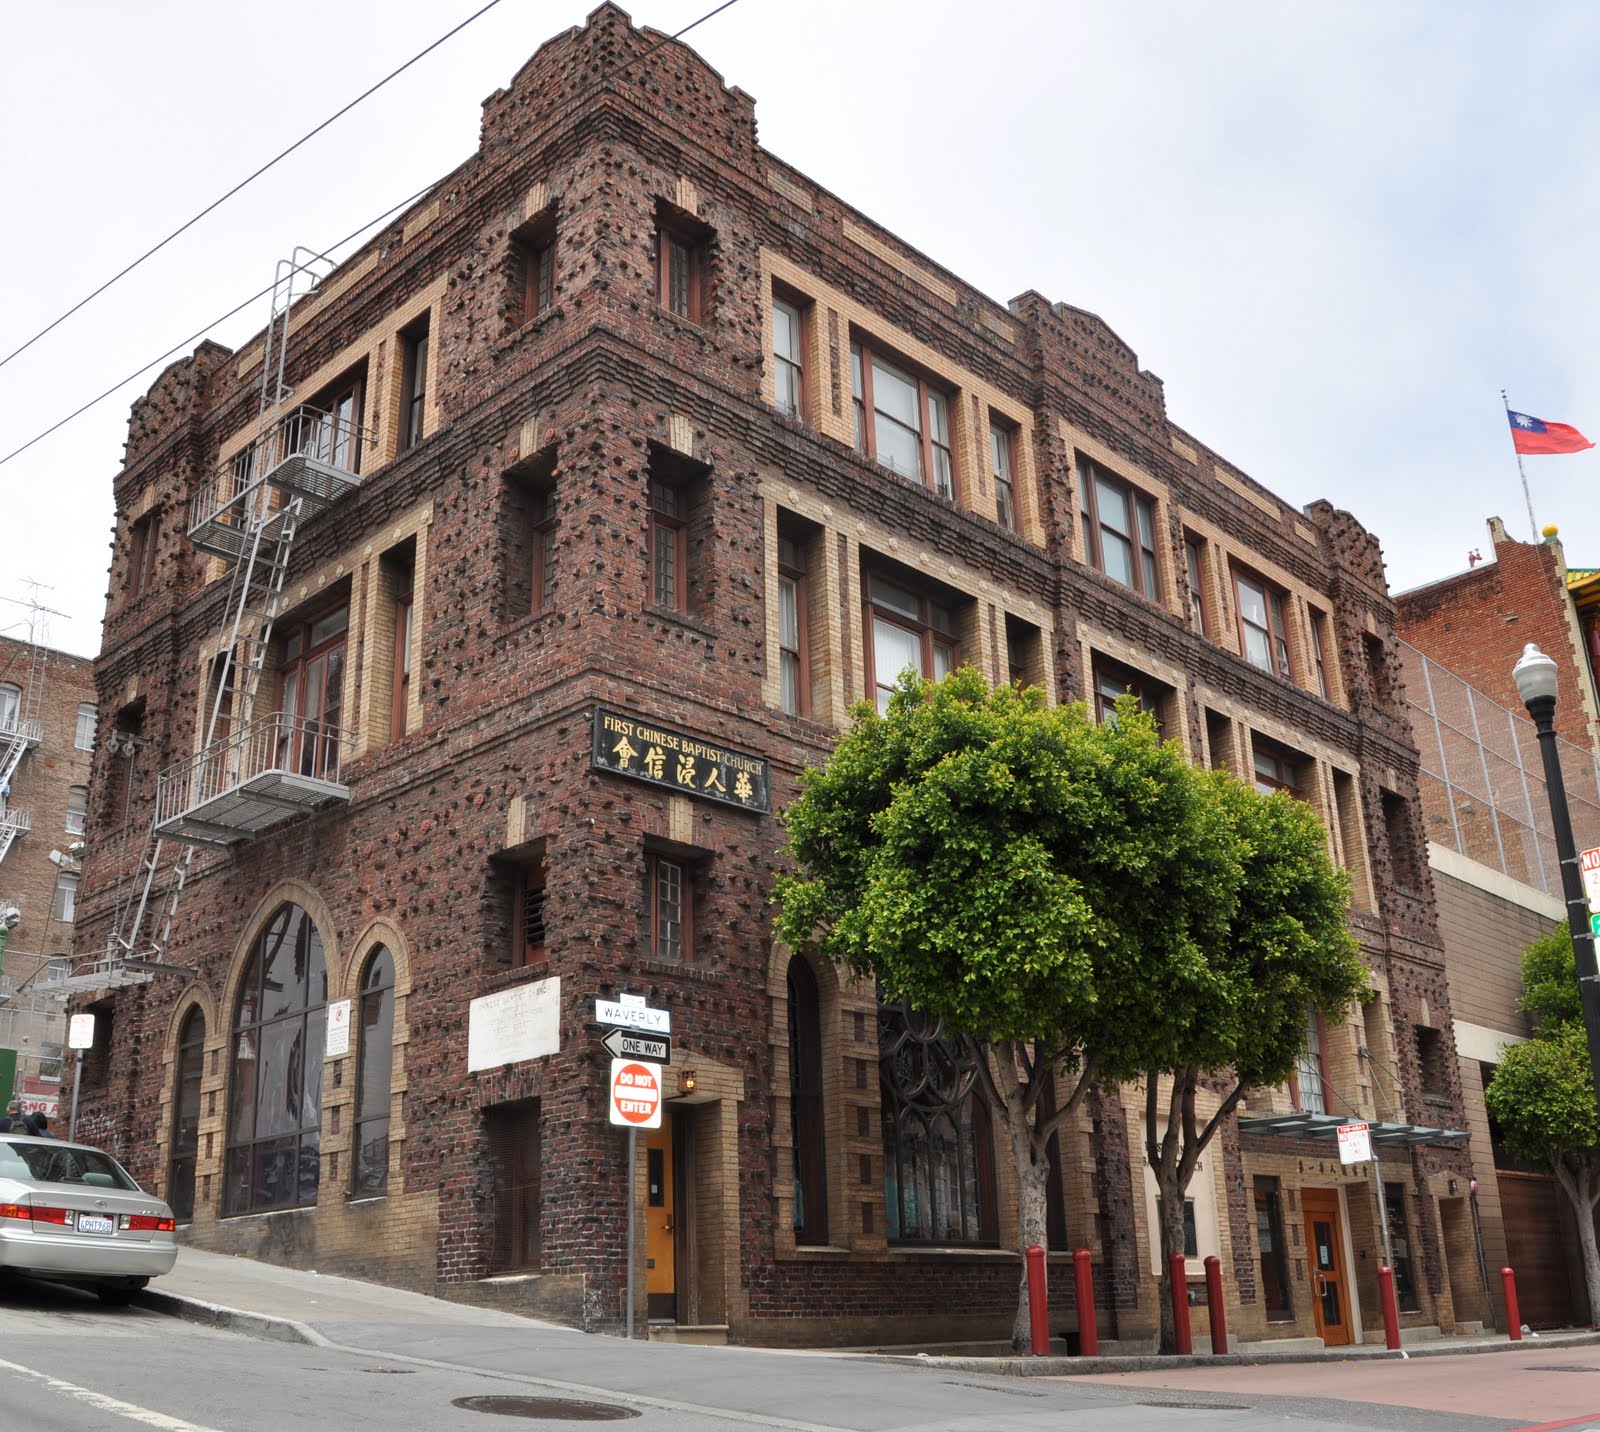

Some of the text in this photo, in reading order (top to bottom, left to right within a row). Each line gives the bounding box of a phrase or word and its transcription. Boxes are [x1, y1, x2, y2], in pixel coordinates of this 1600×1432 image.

[604, 716, 763, 776] FIRST CHINESE BAPTIST CHURCH
[604, 1007, 662, 1025] WAVERLY
[622, 1038, 664, 1056] ONE WAY
[620, 1072, 653, 1088] DO NOT
[620, 1100, 653, 1115] ENTER
[80, 1219, 112, 1232] 4PHT968
